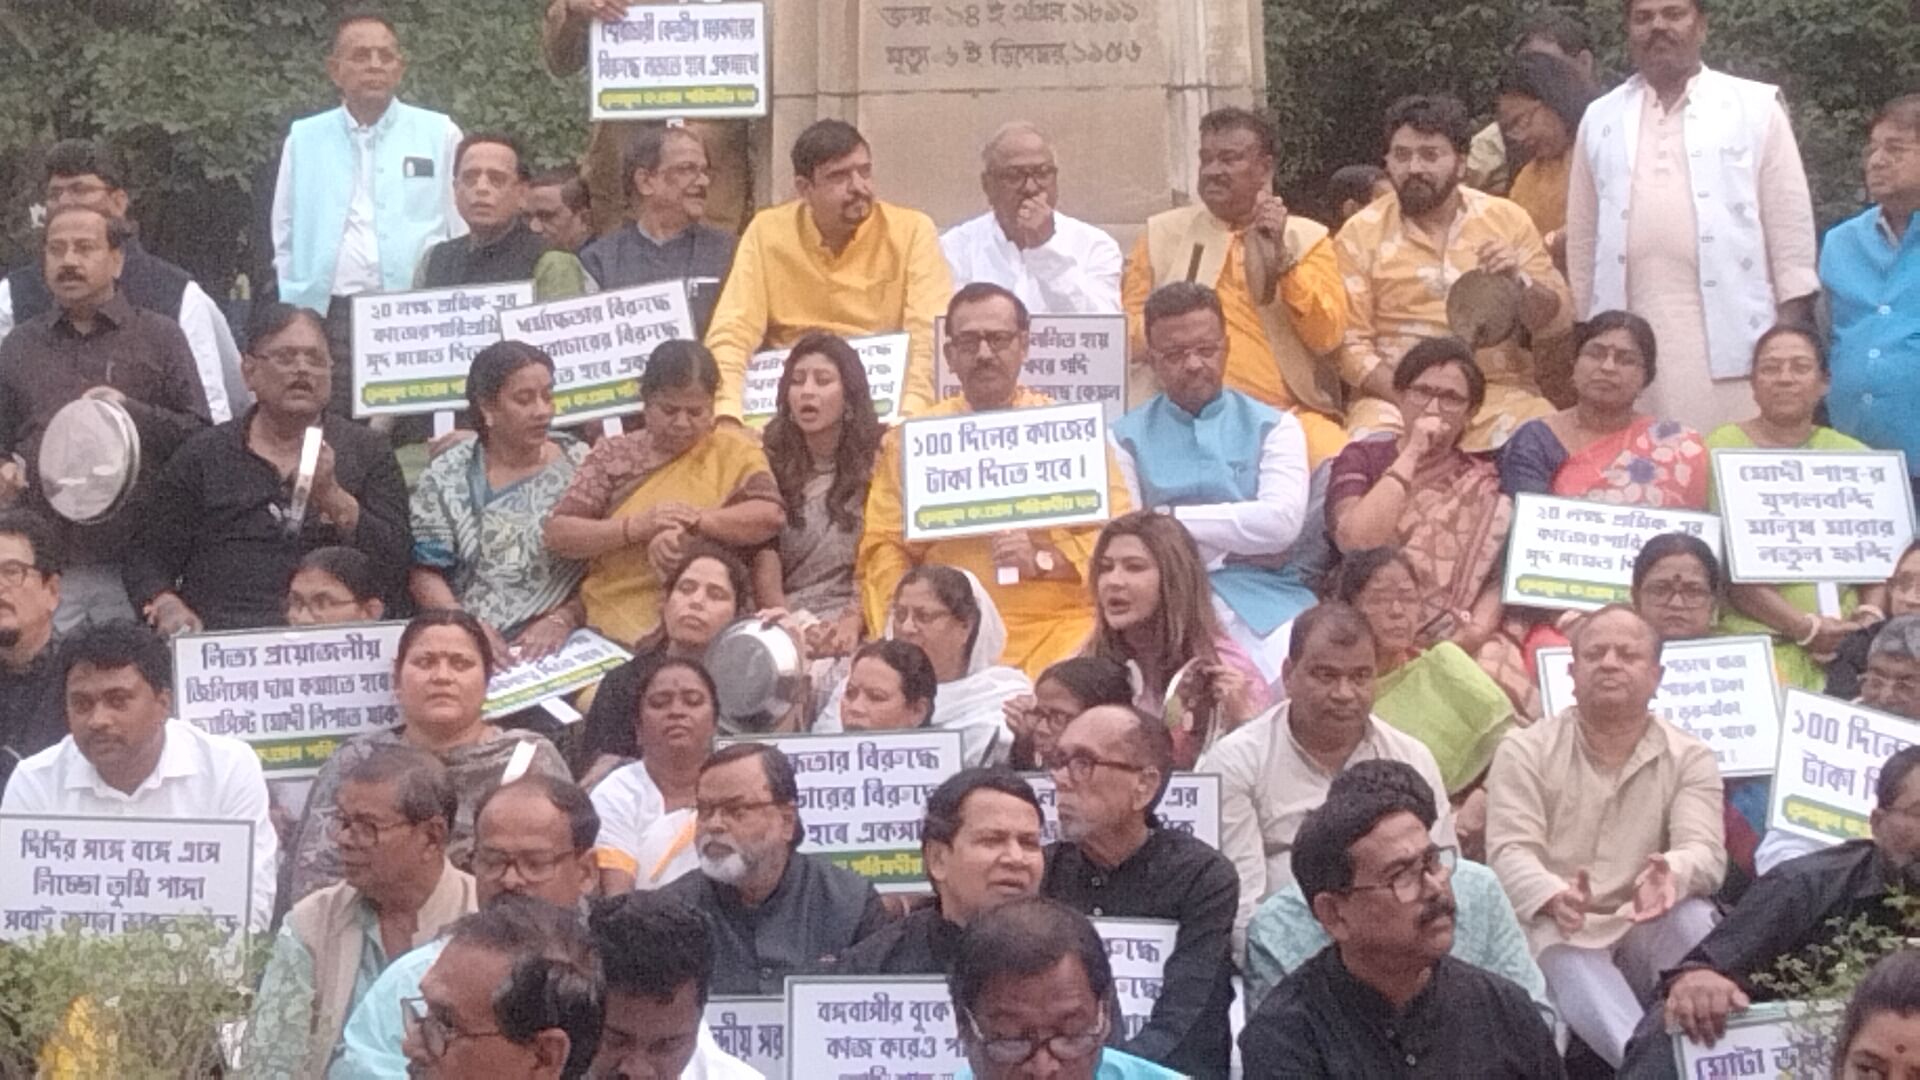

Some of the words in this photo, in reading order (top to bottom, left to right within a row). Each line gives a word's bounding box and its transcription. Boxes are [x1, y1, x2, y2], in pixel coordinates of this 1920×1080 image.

[606, 293, 671, 319] বিরুদ্ধে
[913, 432, 952, 456] ১০০
[959, 421, 1019, 452] দিনের
[1024, 416, 1097, 442] কাজের
[925, 465, 972, 493] টাকা
[978, 457, 1029, 489] দিতে
[1035, 458, 1072, 482] হবে
[1739, 460, 1804, 482] মোদী
[1745, 519, 1815, 544] মানুষ
[1823, 519, 1895, 538] মারার
[1756, 546, 1823, 572] নতুন
[201, 641, 258, 669] নিত্য
[263, 633, 381, 666] প্রয়োজনীয়
[186, 675, 259, 704] জিনিসের
[264, 678, 294, 699] দাম
[299, 674, 355, 695] কমাতে
[360, 672, 390, 693] হবে
[262, 703, 304, 732] মোদী
[309, 702, 361, 729] নিপাত
[1792, 709, 1840, 745] ১০০
[857, 741, 940, 772] বিরুদ্ধে
[1802, 749, 1856, 796] টাকা
[21, 829, 76, 862] দিদির
[82, 838, 125, 862] সঙ্গে
[131, 839, 171, 863] বঙ্গে
[177, 840, 221, 864] এসে
[807, 822, 849, 846] হবে
[106, 868, 151, 907] তুমি
[158, 875, 205, 900] পাঙ্গা
[817, 992, 903, 1024] বঙ্গবাসীর
[910, 1001, 950, 1033] বুকে
[826, 1036, 876, 1059] কাজ
[879, 1035, 936, 1060] করেও
[1695, 1044, 1766, 1080] মোটা
